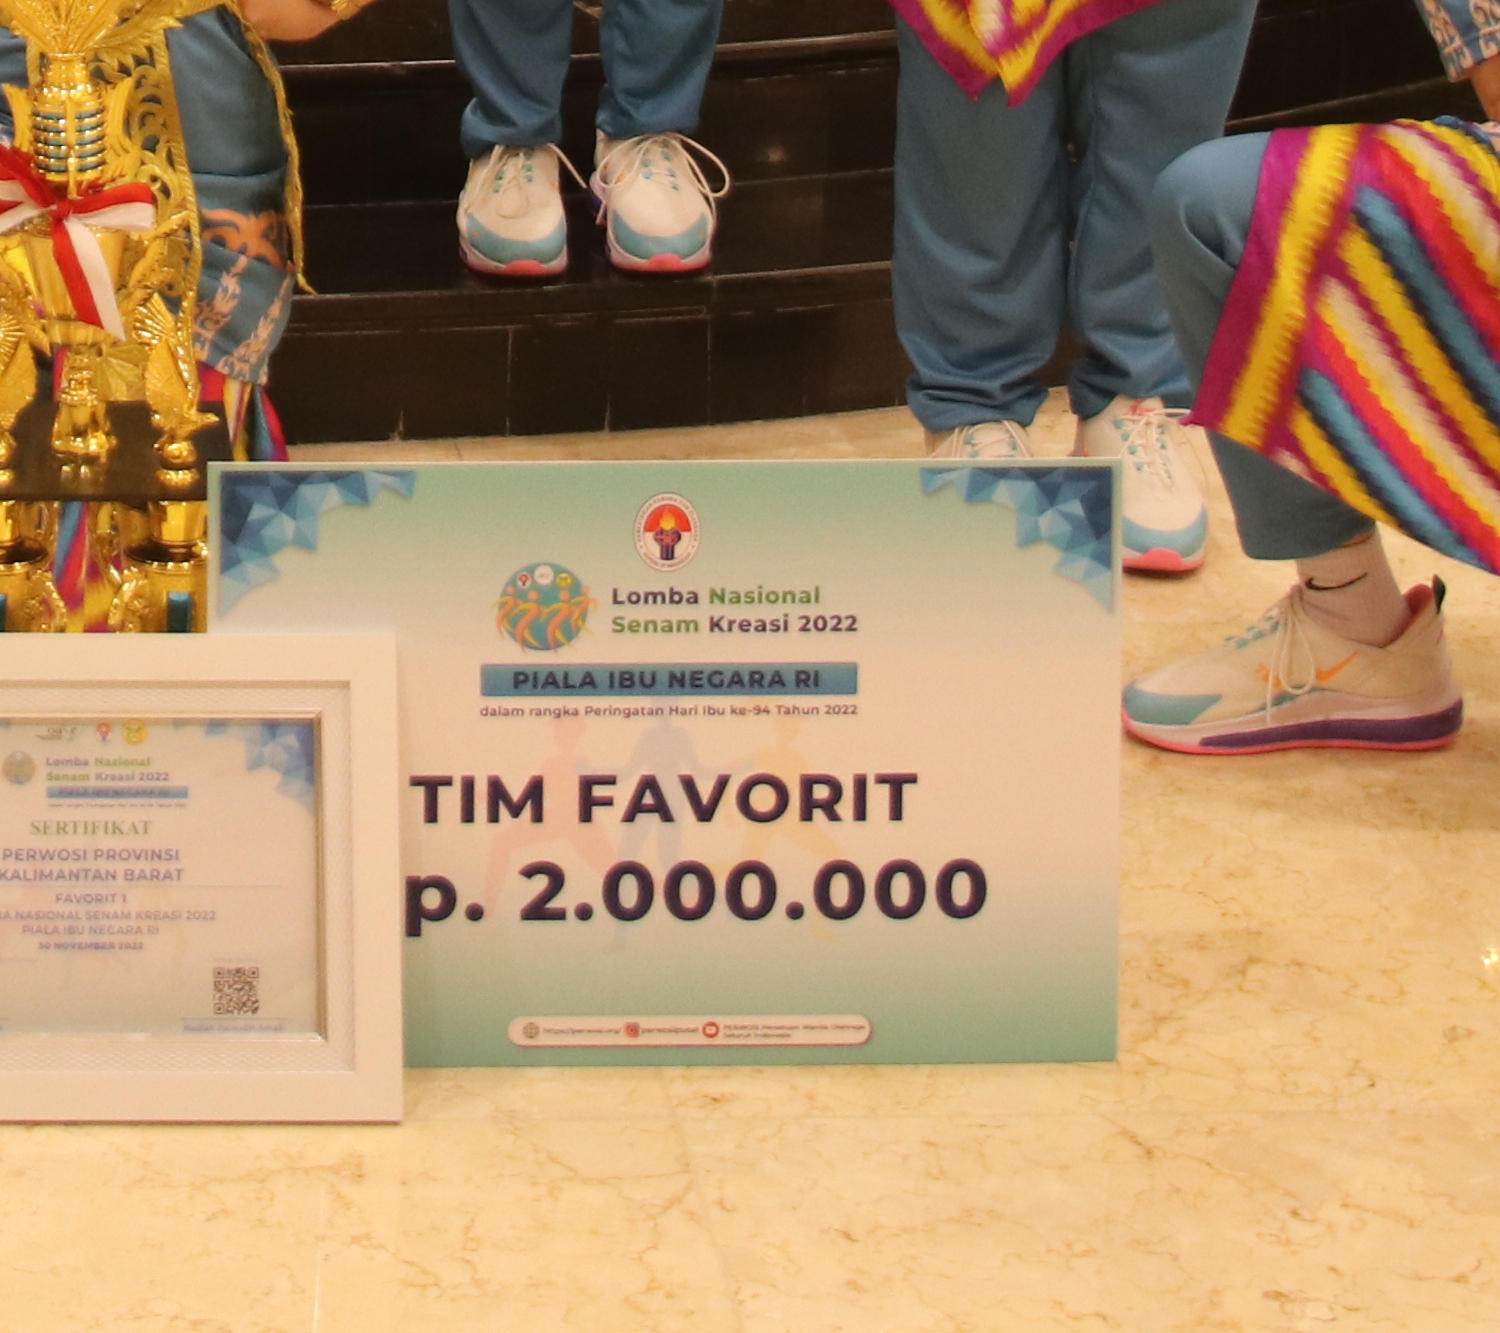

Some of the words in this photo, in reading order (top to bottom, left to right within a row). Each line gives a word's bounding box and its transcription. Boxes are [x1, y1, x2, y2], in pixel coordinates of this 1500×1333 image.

[612, 587, 699, 605] Lomba
[708, 586, 820, 605] Nasional
[612, 615, 699, 634] Senam
[708, 614, 789, 633] Kreasi
[797, 614, 858, 633] 2022
[512, 670, 598, 690] PIALA
[608, 670, 656, 690] IBU
[668, 669, 784, 689] NEGARA
[794, 669, 820, 688] RI
[480, 705, 524, 717] dalam
[529, 706, 579, 719] rangka
[584, 705, 664, 719] Peringatan
[669, 704, 698, 716] Hari
[703, 705, 725, 716] Ibu
[730, 704, 770, 716] ke-94
[776, 704, 819, 715] Tahun
[824, 704, 858, 715] 2022
[46, 757, 89, 767] Lomba
[95, 756, 151, 767] Nasional
[46, 772, 90, 782] Senam
[95, 771, 135, 782] Kreasi
[138, 772, 169, 781] 2022
[410, 774, 545, 824] TIM
[578, 771, 919, 824] FAVORIT
[29, 820, 153, 836] SERTIFIKAT
[2, 848, 87, 861] PERWOSI
[94, 848, 180, 861] PROVINSI
[124, 868, 185, 882] BARAT
[55, 893, 118, 904] FAVORIT
[121, 893, 128, 904] 1
[404, 873, 485, 937] p.
[518, 858, 988, 925] 2.000.000
[15, 910, 82, 921] NASIONAL
[85, 910, 132, 921] SENAM
[135, 910, 182, 921] KREASI
[186, 910, 216, 921] 2022
[22, 925, 59, 935] PIALA
[63, 925, 84, 935] IBU
[89, 925, 142, 935] NEGARA
[146, 925, 160, 935] RI
[53, 941, 115, 950] NOVEMBER
